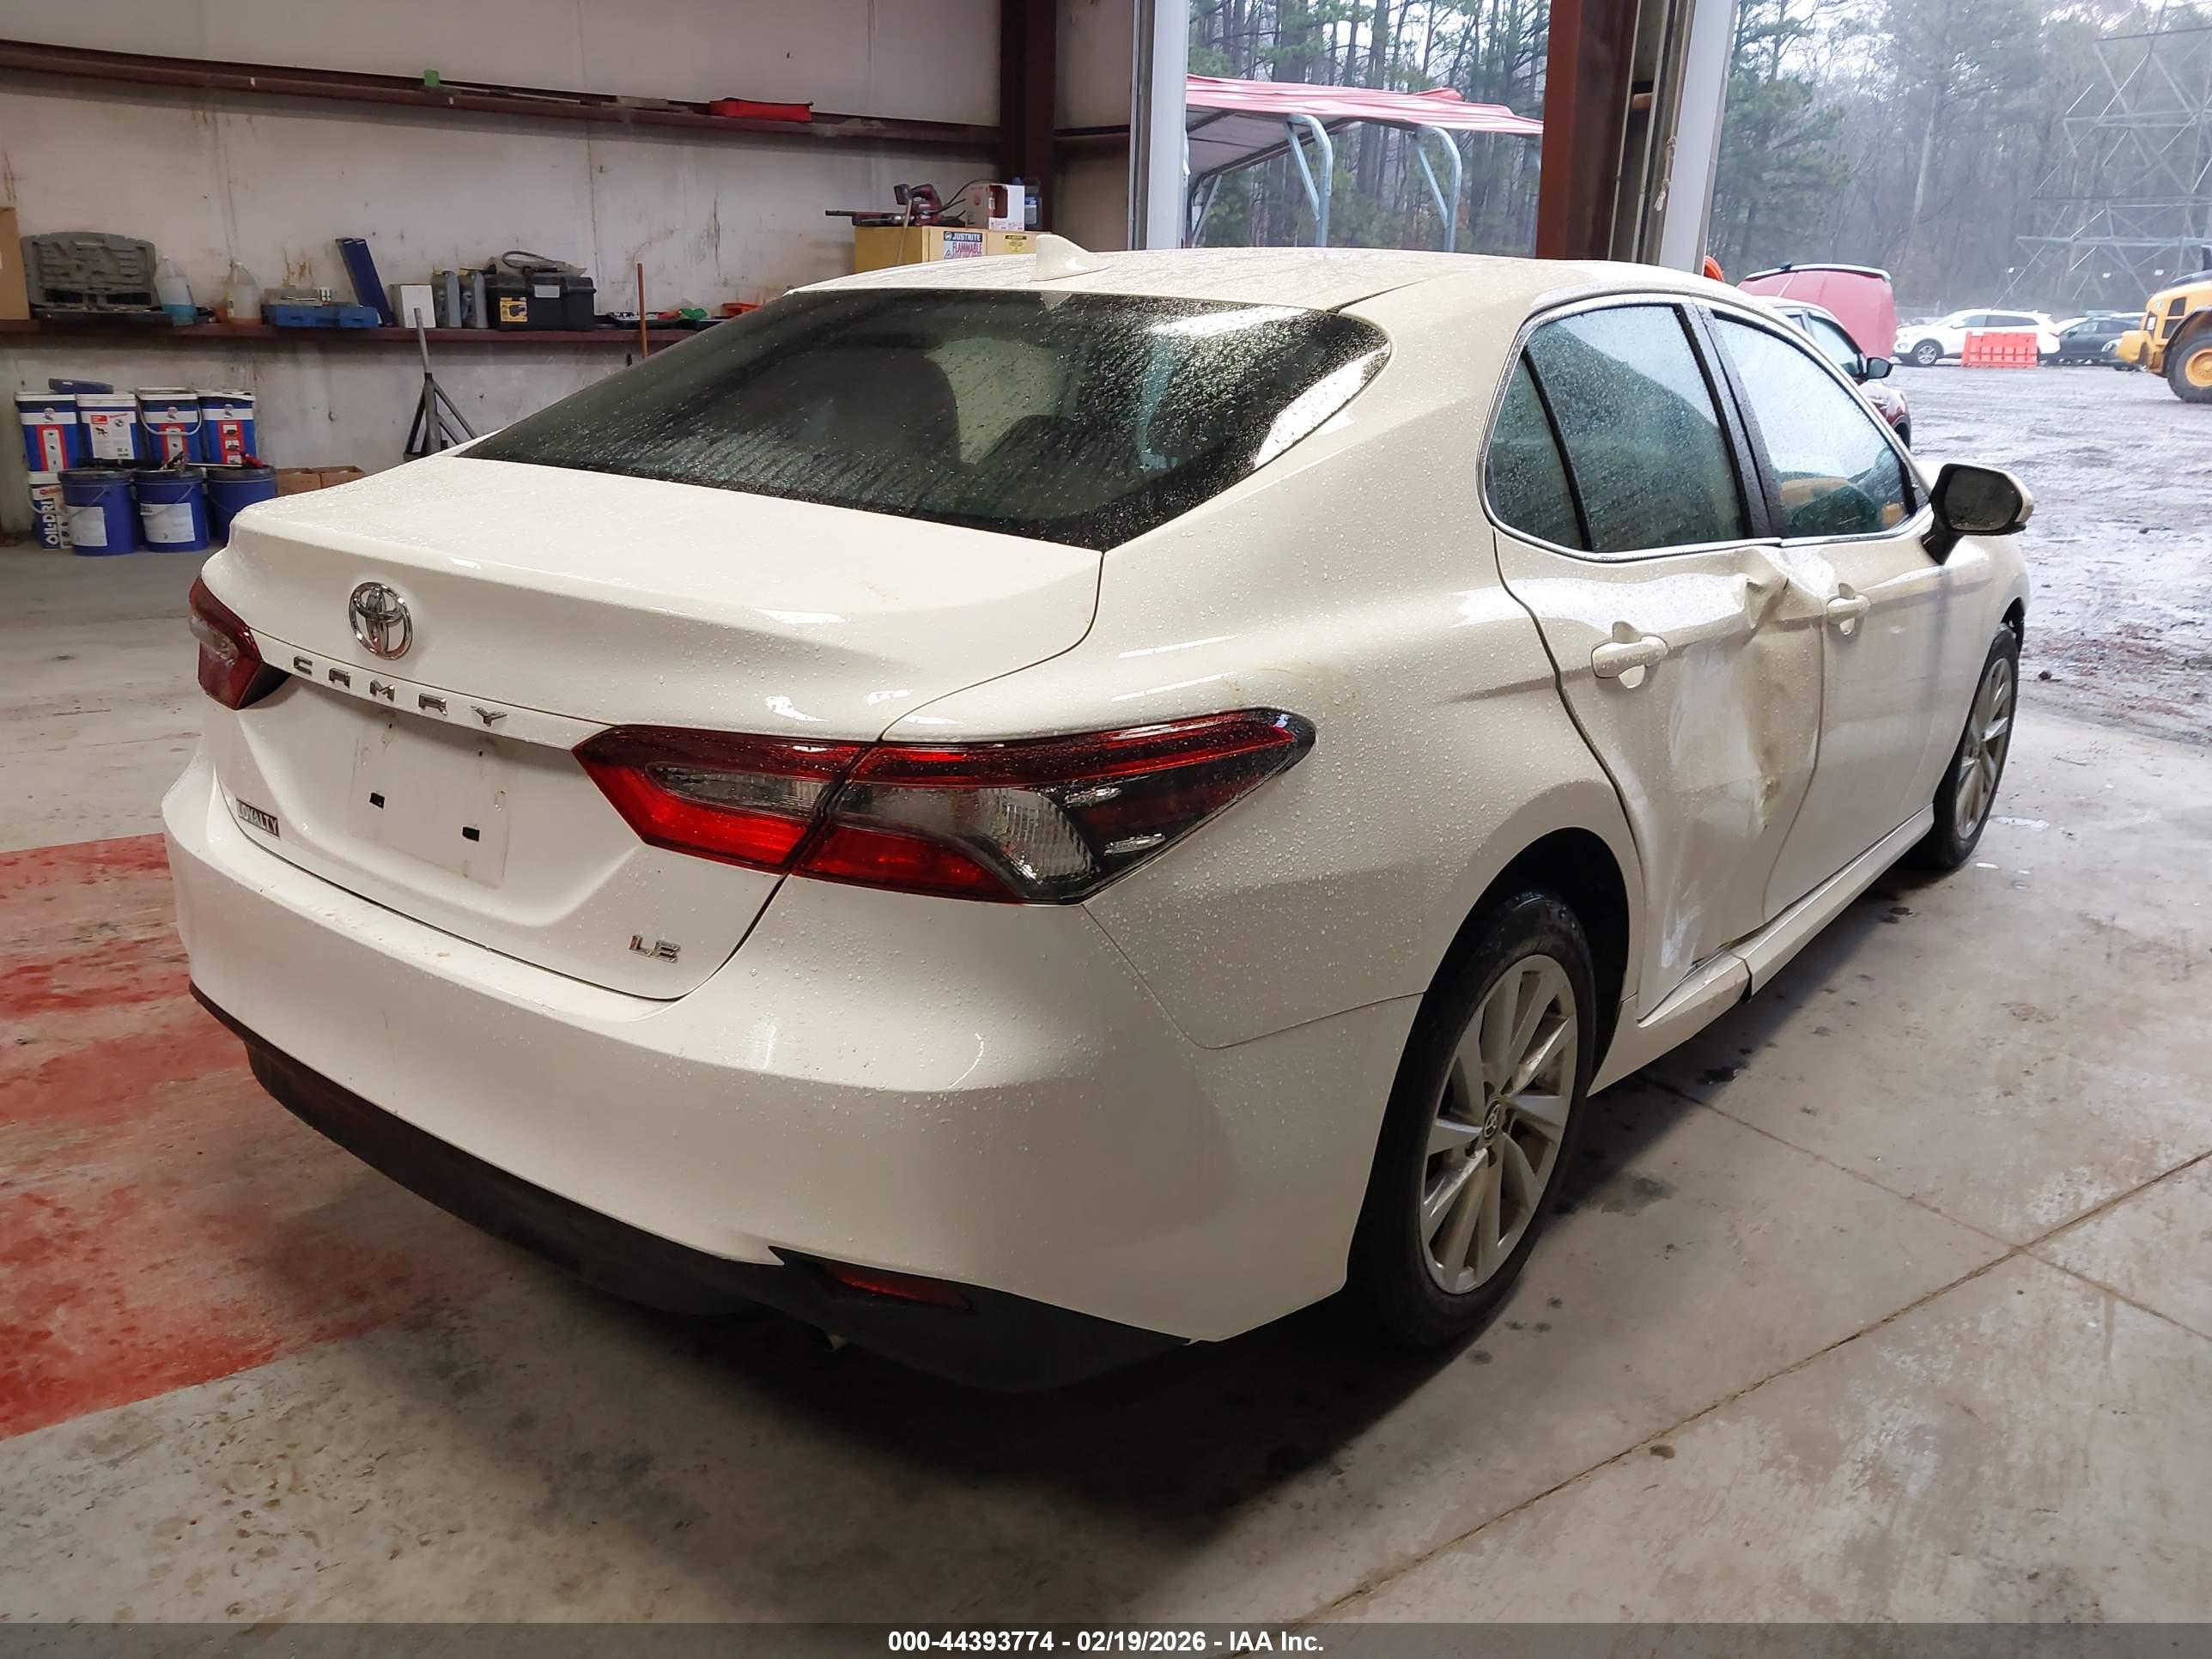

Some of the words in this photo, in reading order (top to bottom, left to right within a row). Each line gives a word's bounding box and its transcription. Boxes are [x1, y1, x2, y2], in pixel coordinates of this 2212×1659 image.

[952, 232, 981, 241] JUSTRITE
[952, 241, 982, 254] FLAMMABLE
[293, 655, 508, 727] CAMRY
[236, 799, 280, 836] LOYALTY
[629, 934, 681, 963] LE
